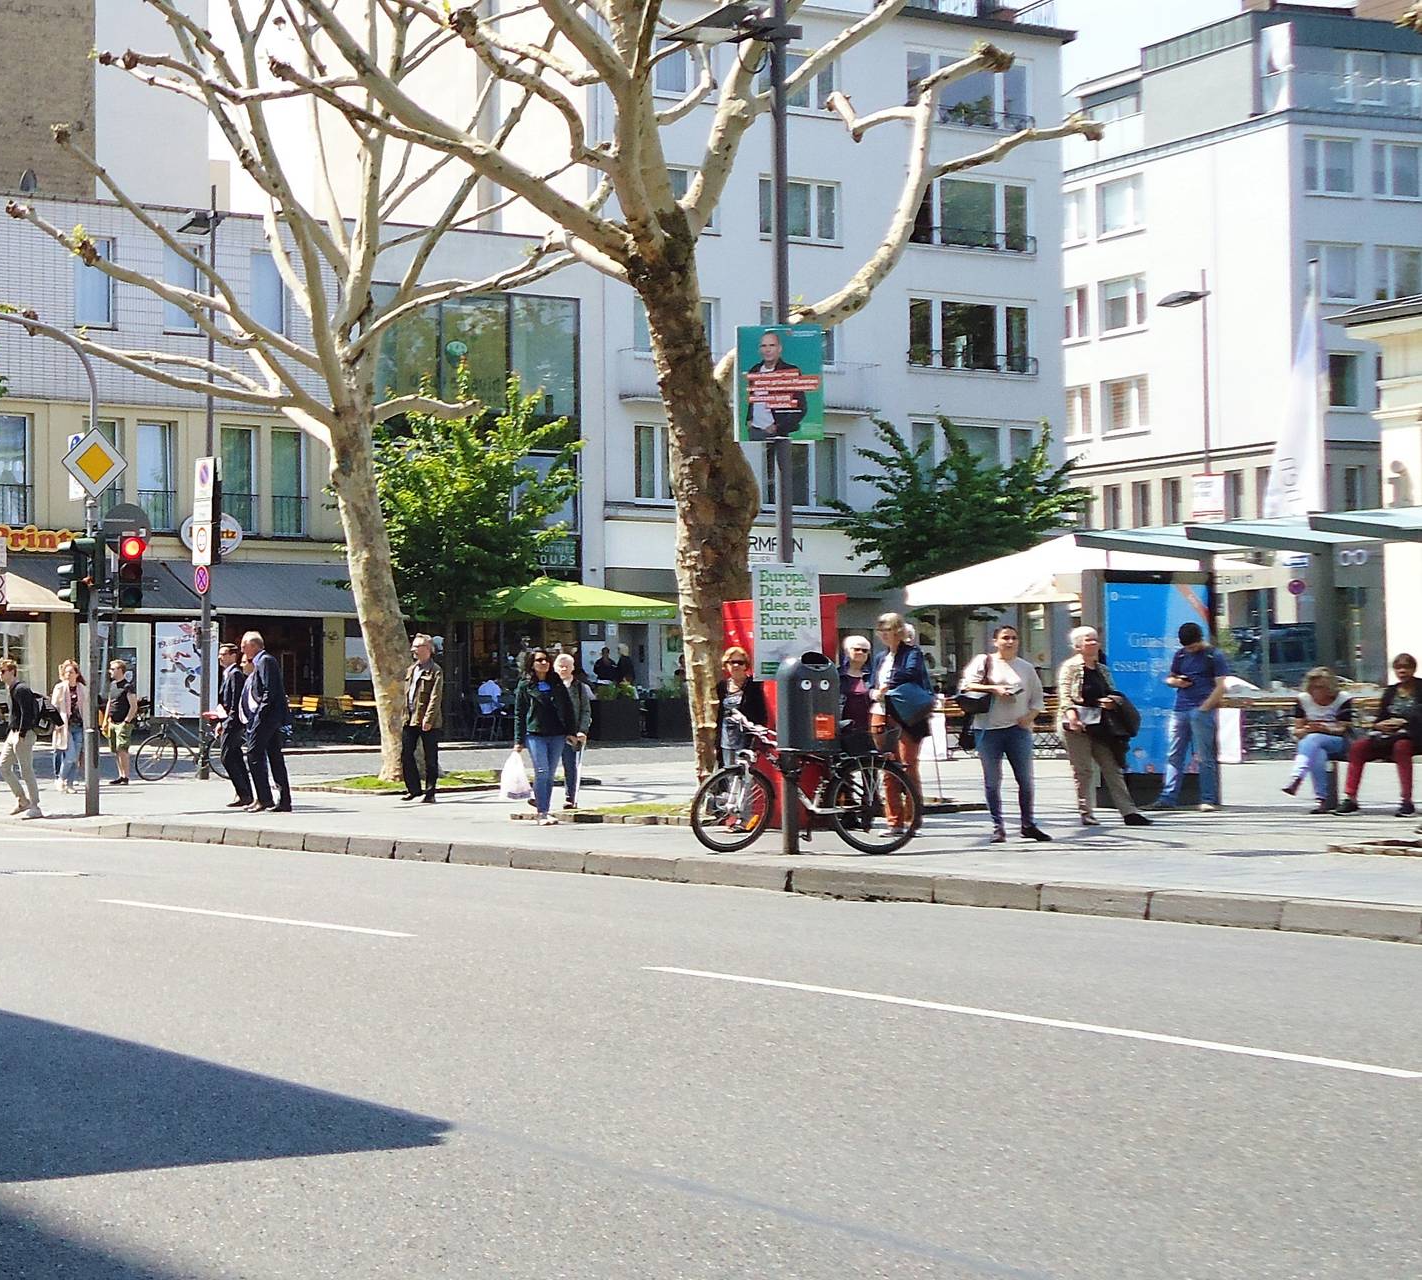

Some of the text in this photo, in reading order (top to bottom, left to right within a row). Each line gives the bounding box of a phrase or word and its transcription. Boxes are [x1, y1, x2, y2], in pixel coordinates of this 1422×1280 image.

[534, 554, 576, 565] OUPS
[760, 584, 813, 597] Die beste
[760, 599, 811, 613] Idee, die
[760, 614, 817, 629] Europa je
[760, 628, 797, 640] hatte.
